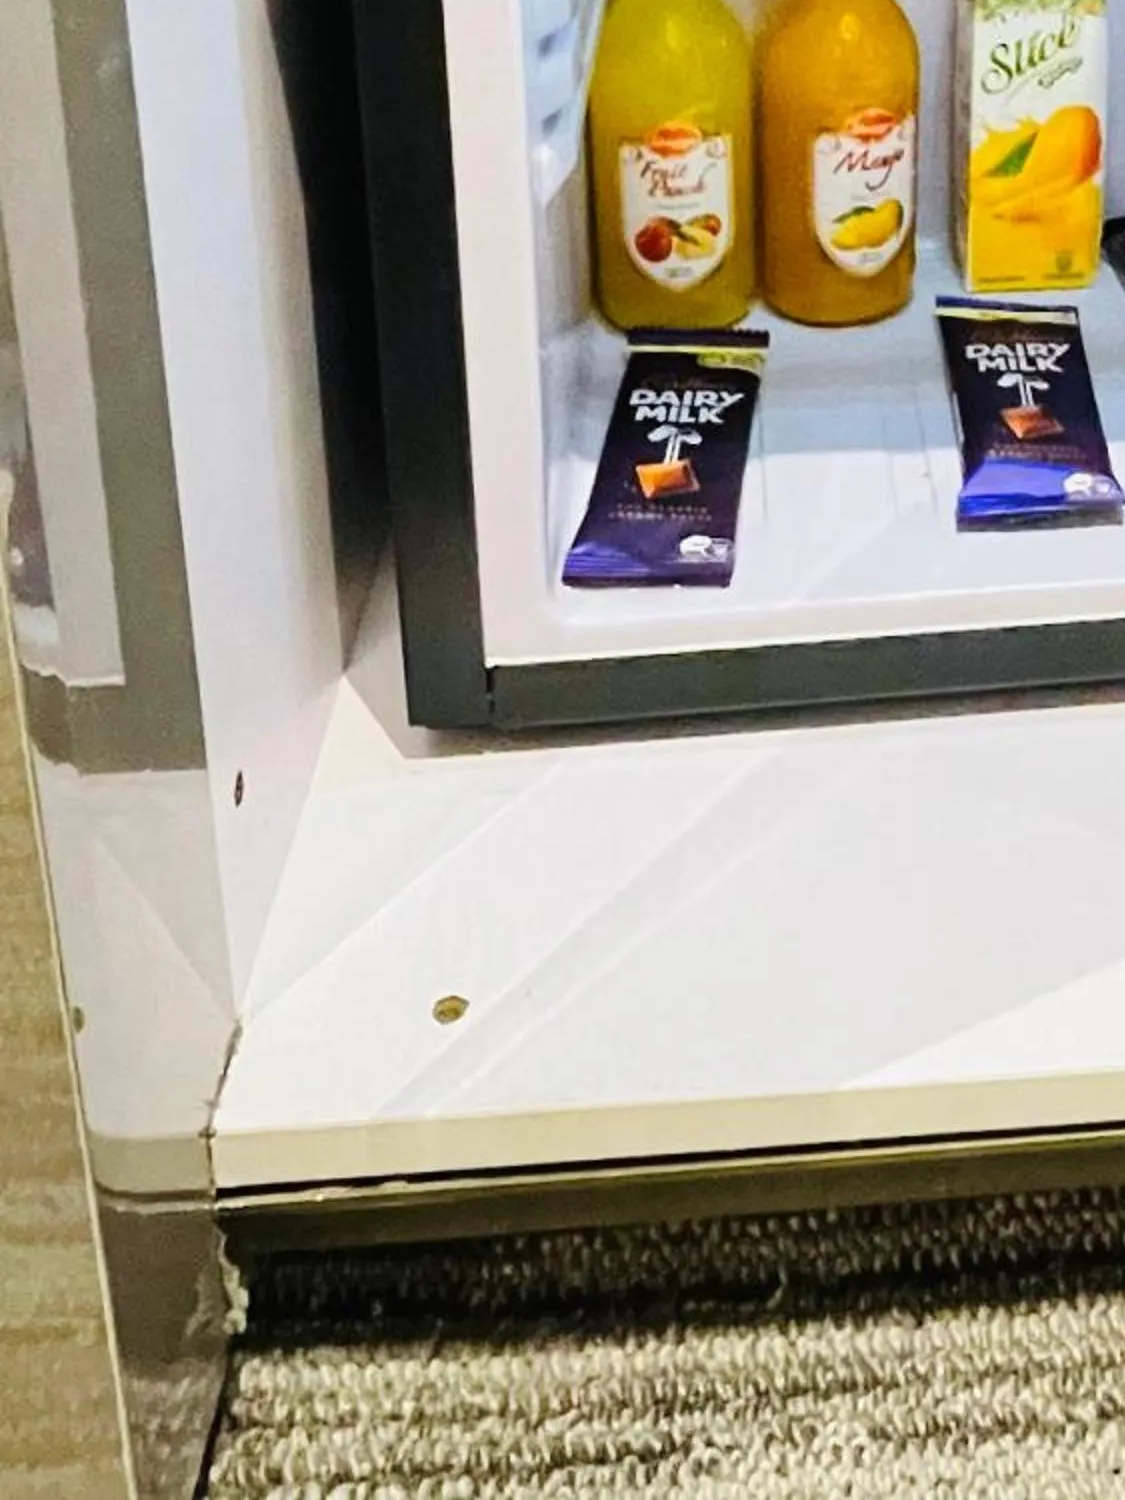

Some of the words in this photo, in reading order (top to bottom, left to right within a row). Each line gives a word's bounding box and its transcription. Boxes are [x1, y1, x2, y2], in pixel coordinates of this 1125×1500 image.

[965, 343, 1071, 359] DAIRY
[976, 356, 1065, 374] MILK
[629, 388, 744, 408] DAIRY
[634, 404, 725, 425] MILK
